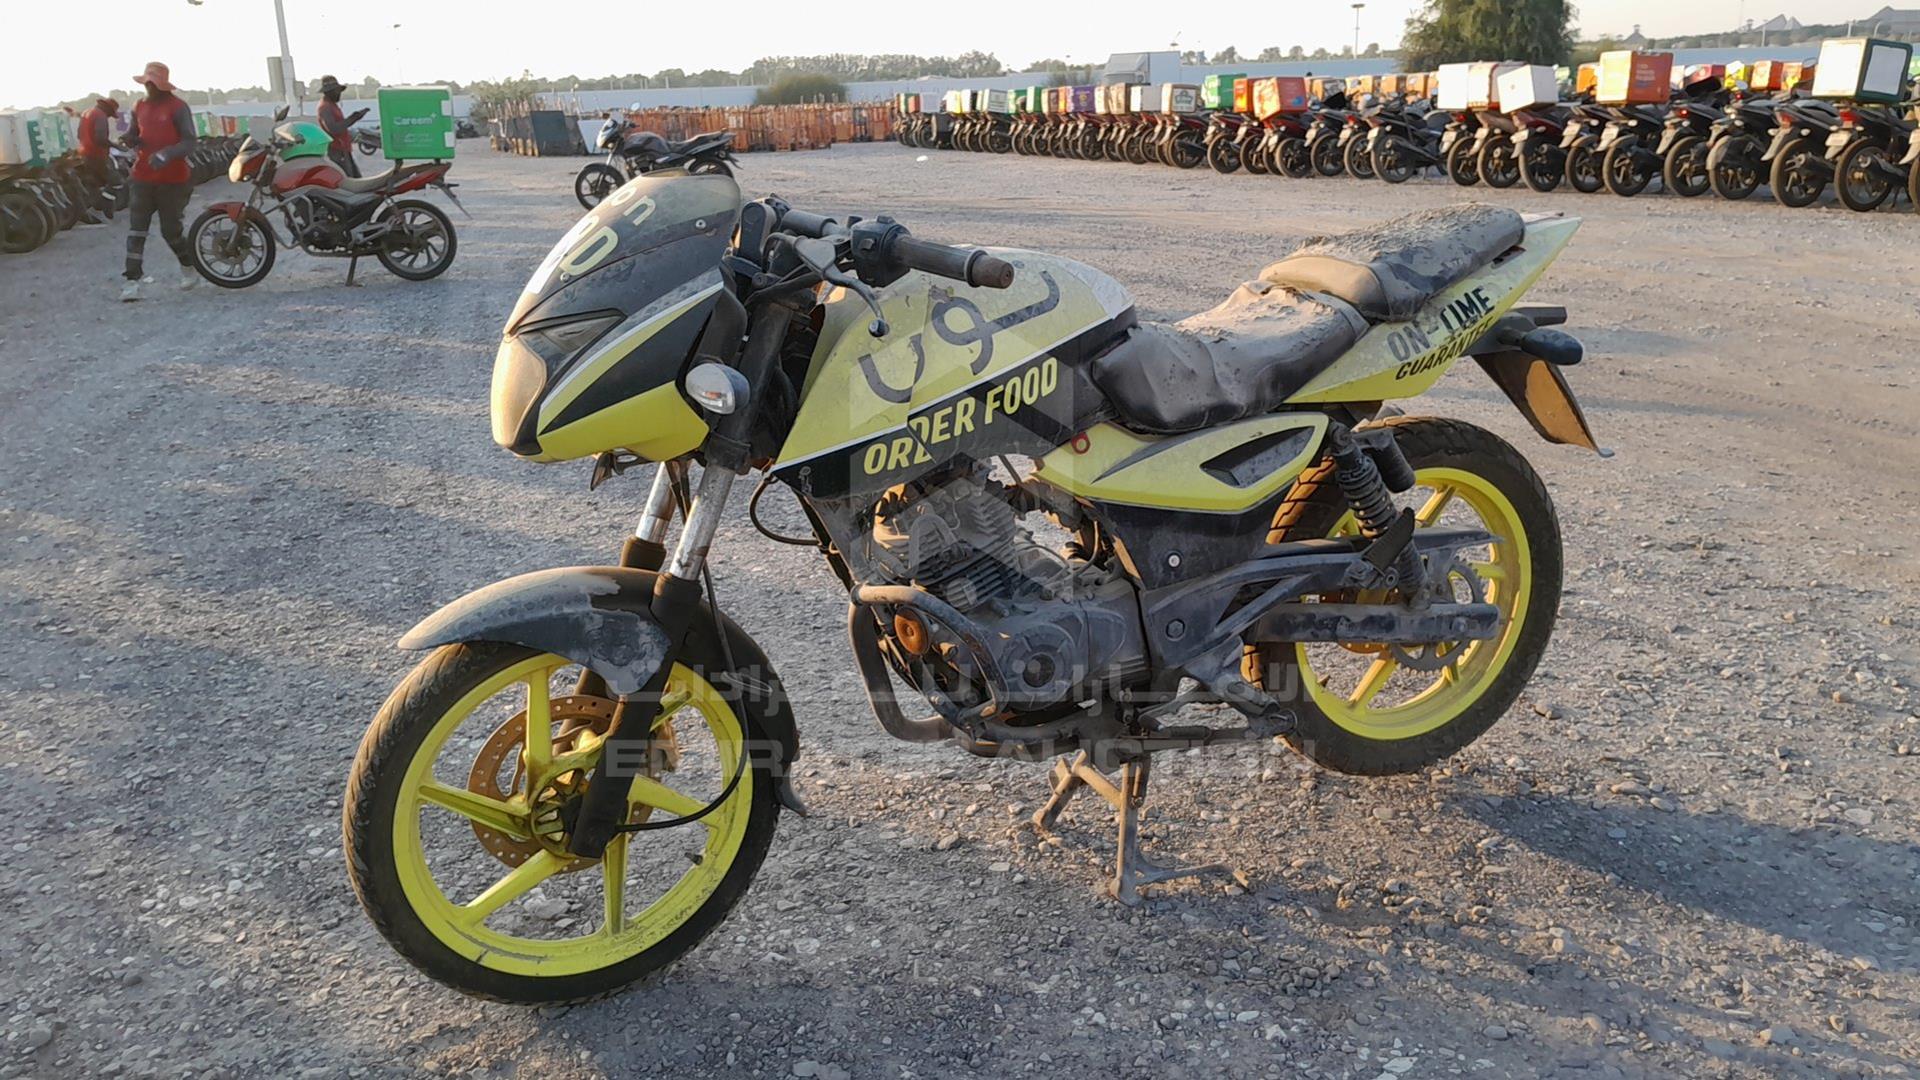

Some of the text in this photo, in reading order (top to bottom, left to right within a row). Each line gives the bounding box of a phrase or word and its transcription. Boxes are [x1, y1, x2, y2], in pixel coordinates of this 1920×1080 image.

[1387, 285, 1495, 362] ON-TIME
[863, 356, 1058, 475] ORDER FOOD
